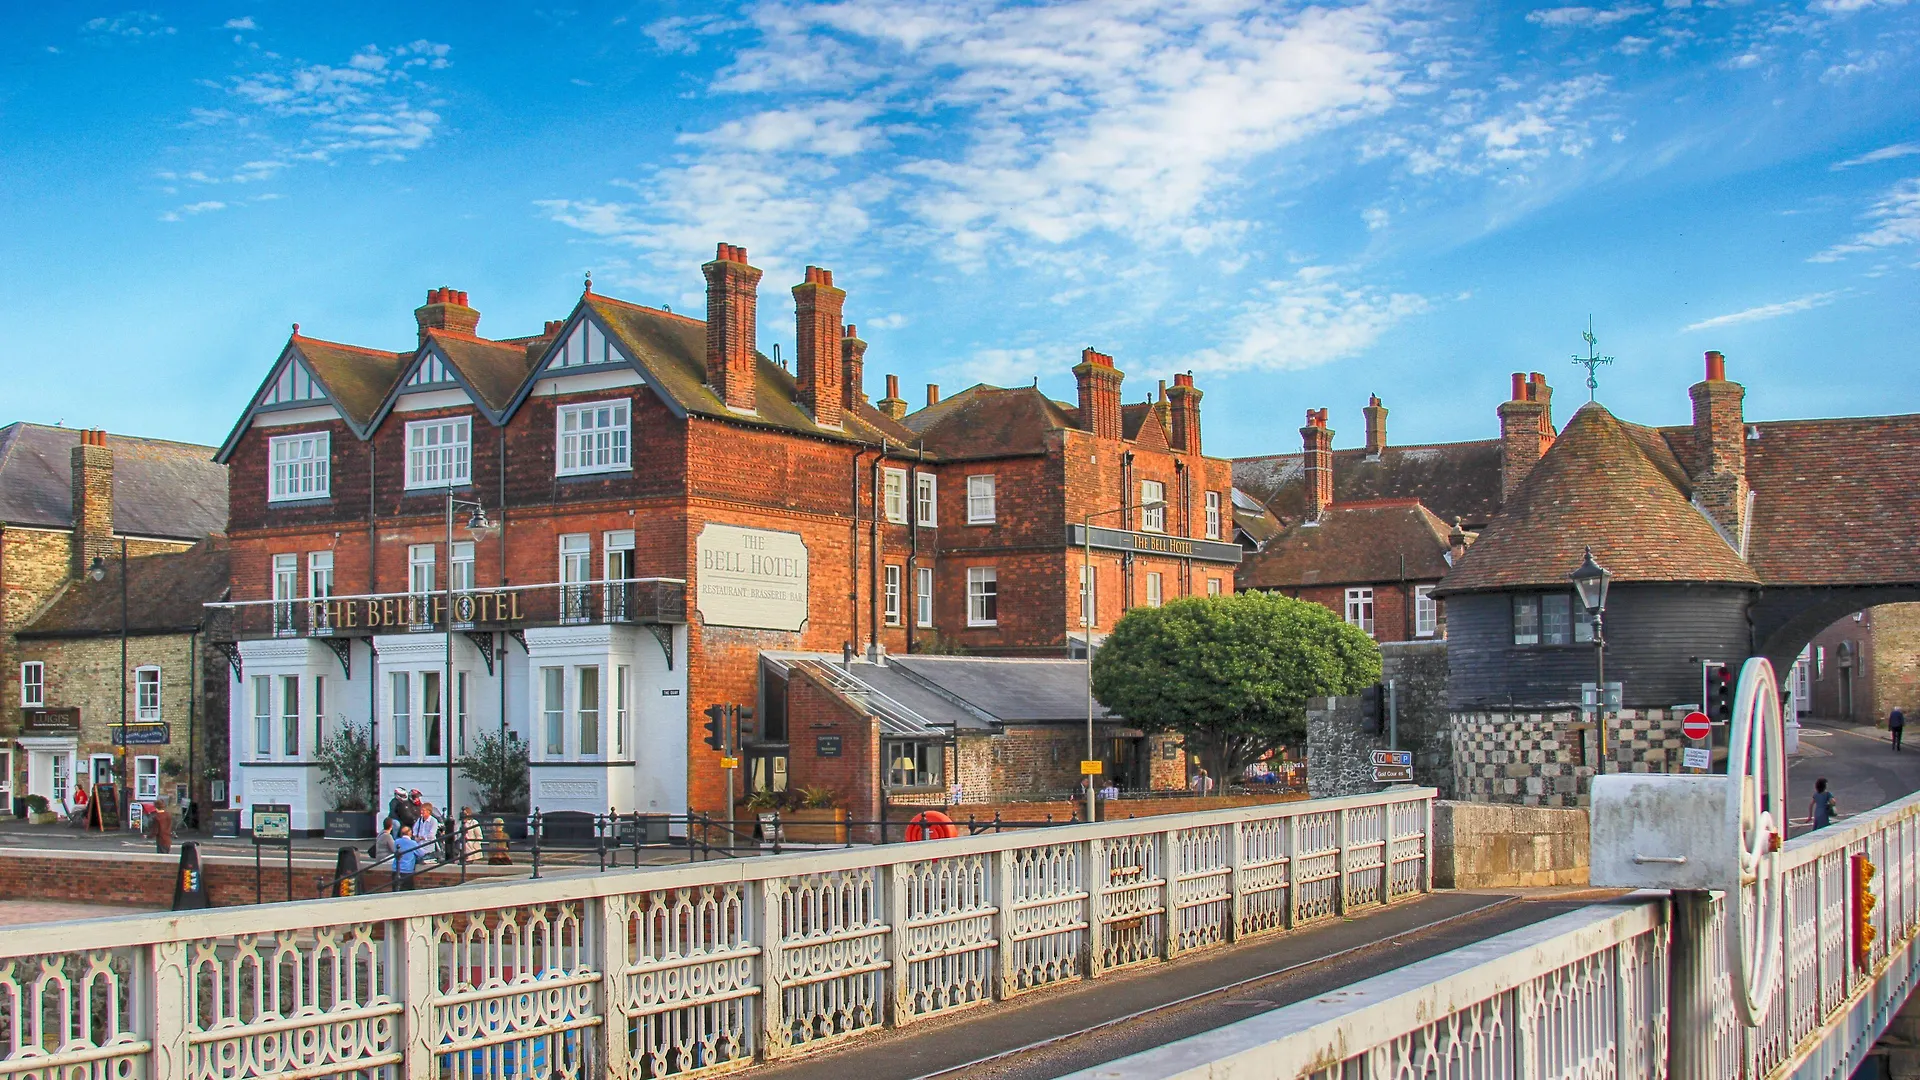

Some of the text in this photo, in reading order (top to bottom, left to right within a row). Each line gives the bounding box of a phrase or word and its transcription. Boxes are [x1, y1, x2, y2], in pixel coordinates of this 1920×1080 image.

[742, 534, 765, 550] THE
[1133, 535, 1193, 555] THE BELL HOTEL
[704, 549, 803, 579] BELL HOTEL
[702, 584, 804, 602] RESTAURANT BRASSERIE BAR
[311, 600, 357, 629] THE
[367, 597, 423, 627] BELL
